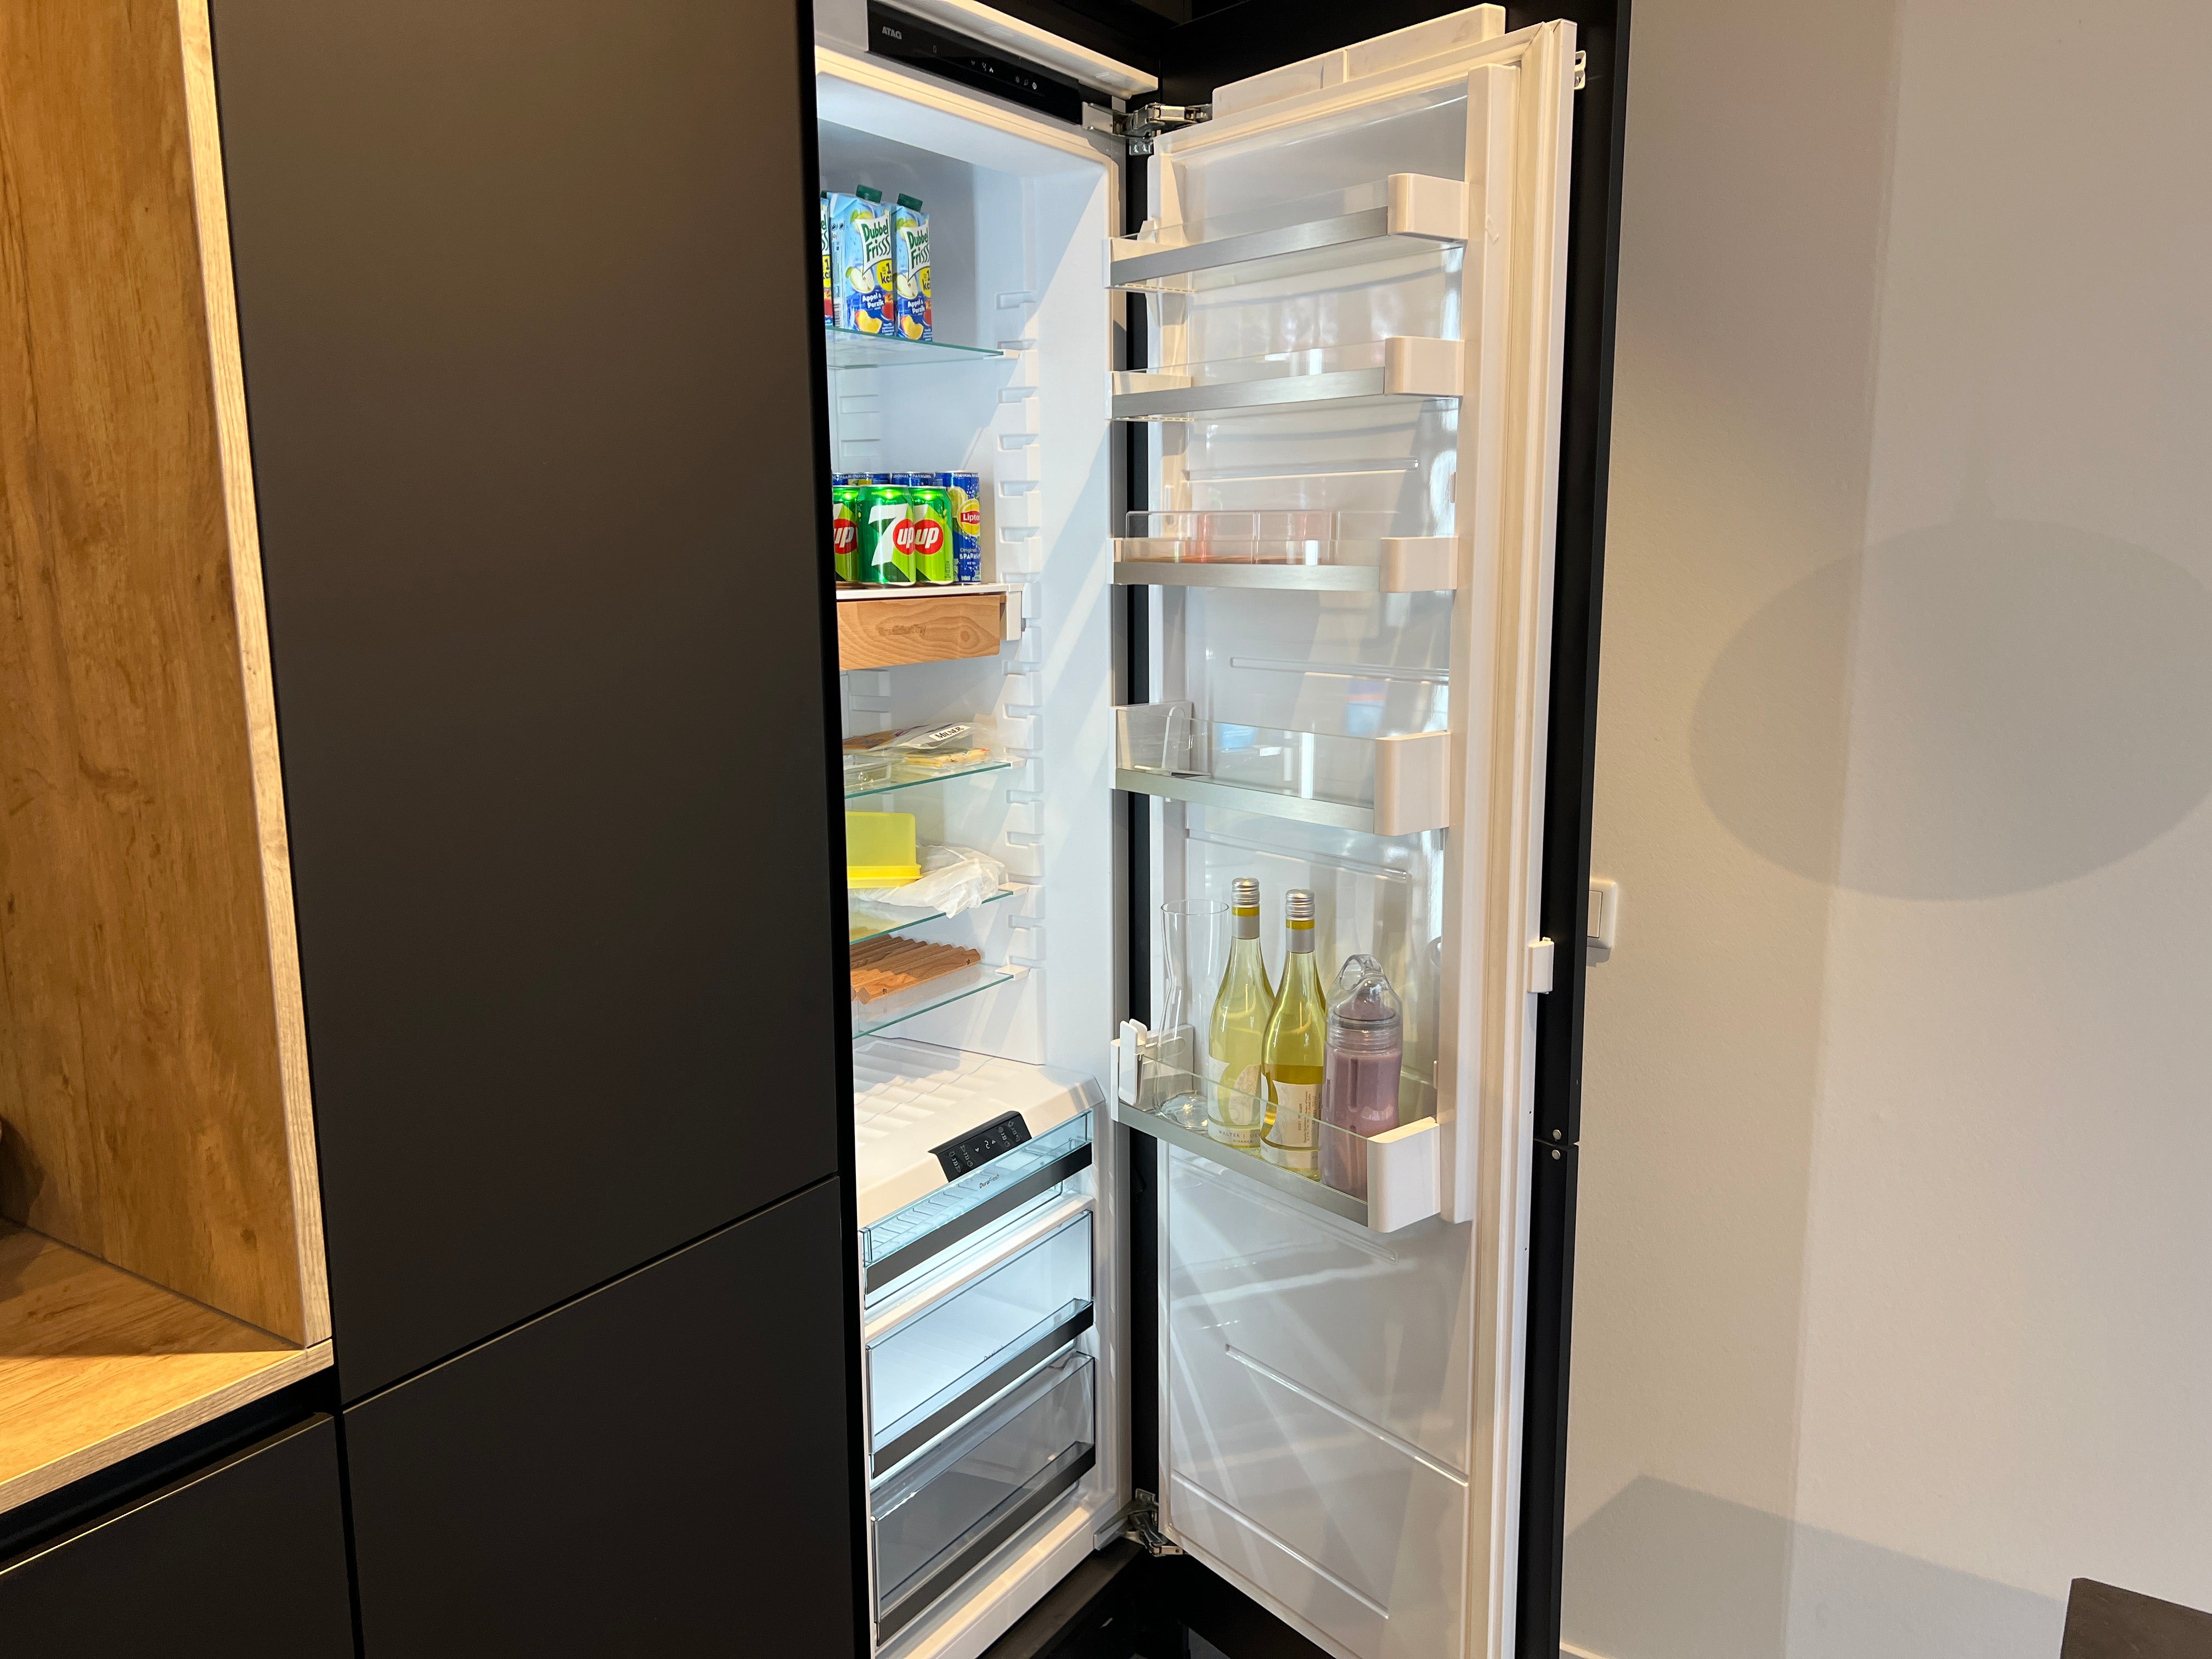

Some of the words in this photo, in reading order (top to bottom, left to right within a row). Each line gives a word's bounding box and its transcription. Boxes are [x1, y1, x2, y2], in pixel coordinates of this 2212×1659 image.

[882, 26, 902, 40] ATAG
[861, 218, 888, 242] Dubbel
[906, 227, 928, 250] Dubbel
[862, 292, 878, 302] Appel
[907, 298, 921, 308] Appel
[867, 300, 884, 308] Perzik
[963, 513, 980, 523] Lipto
[915, 527, 940, 549] up
[934, 726, 964, 739] MILNER
